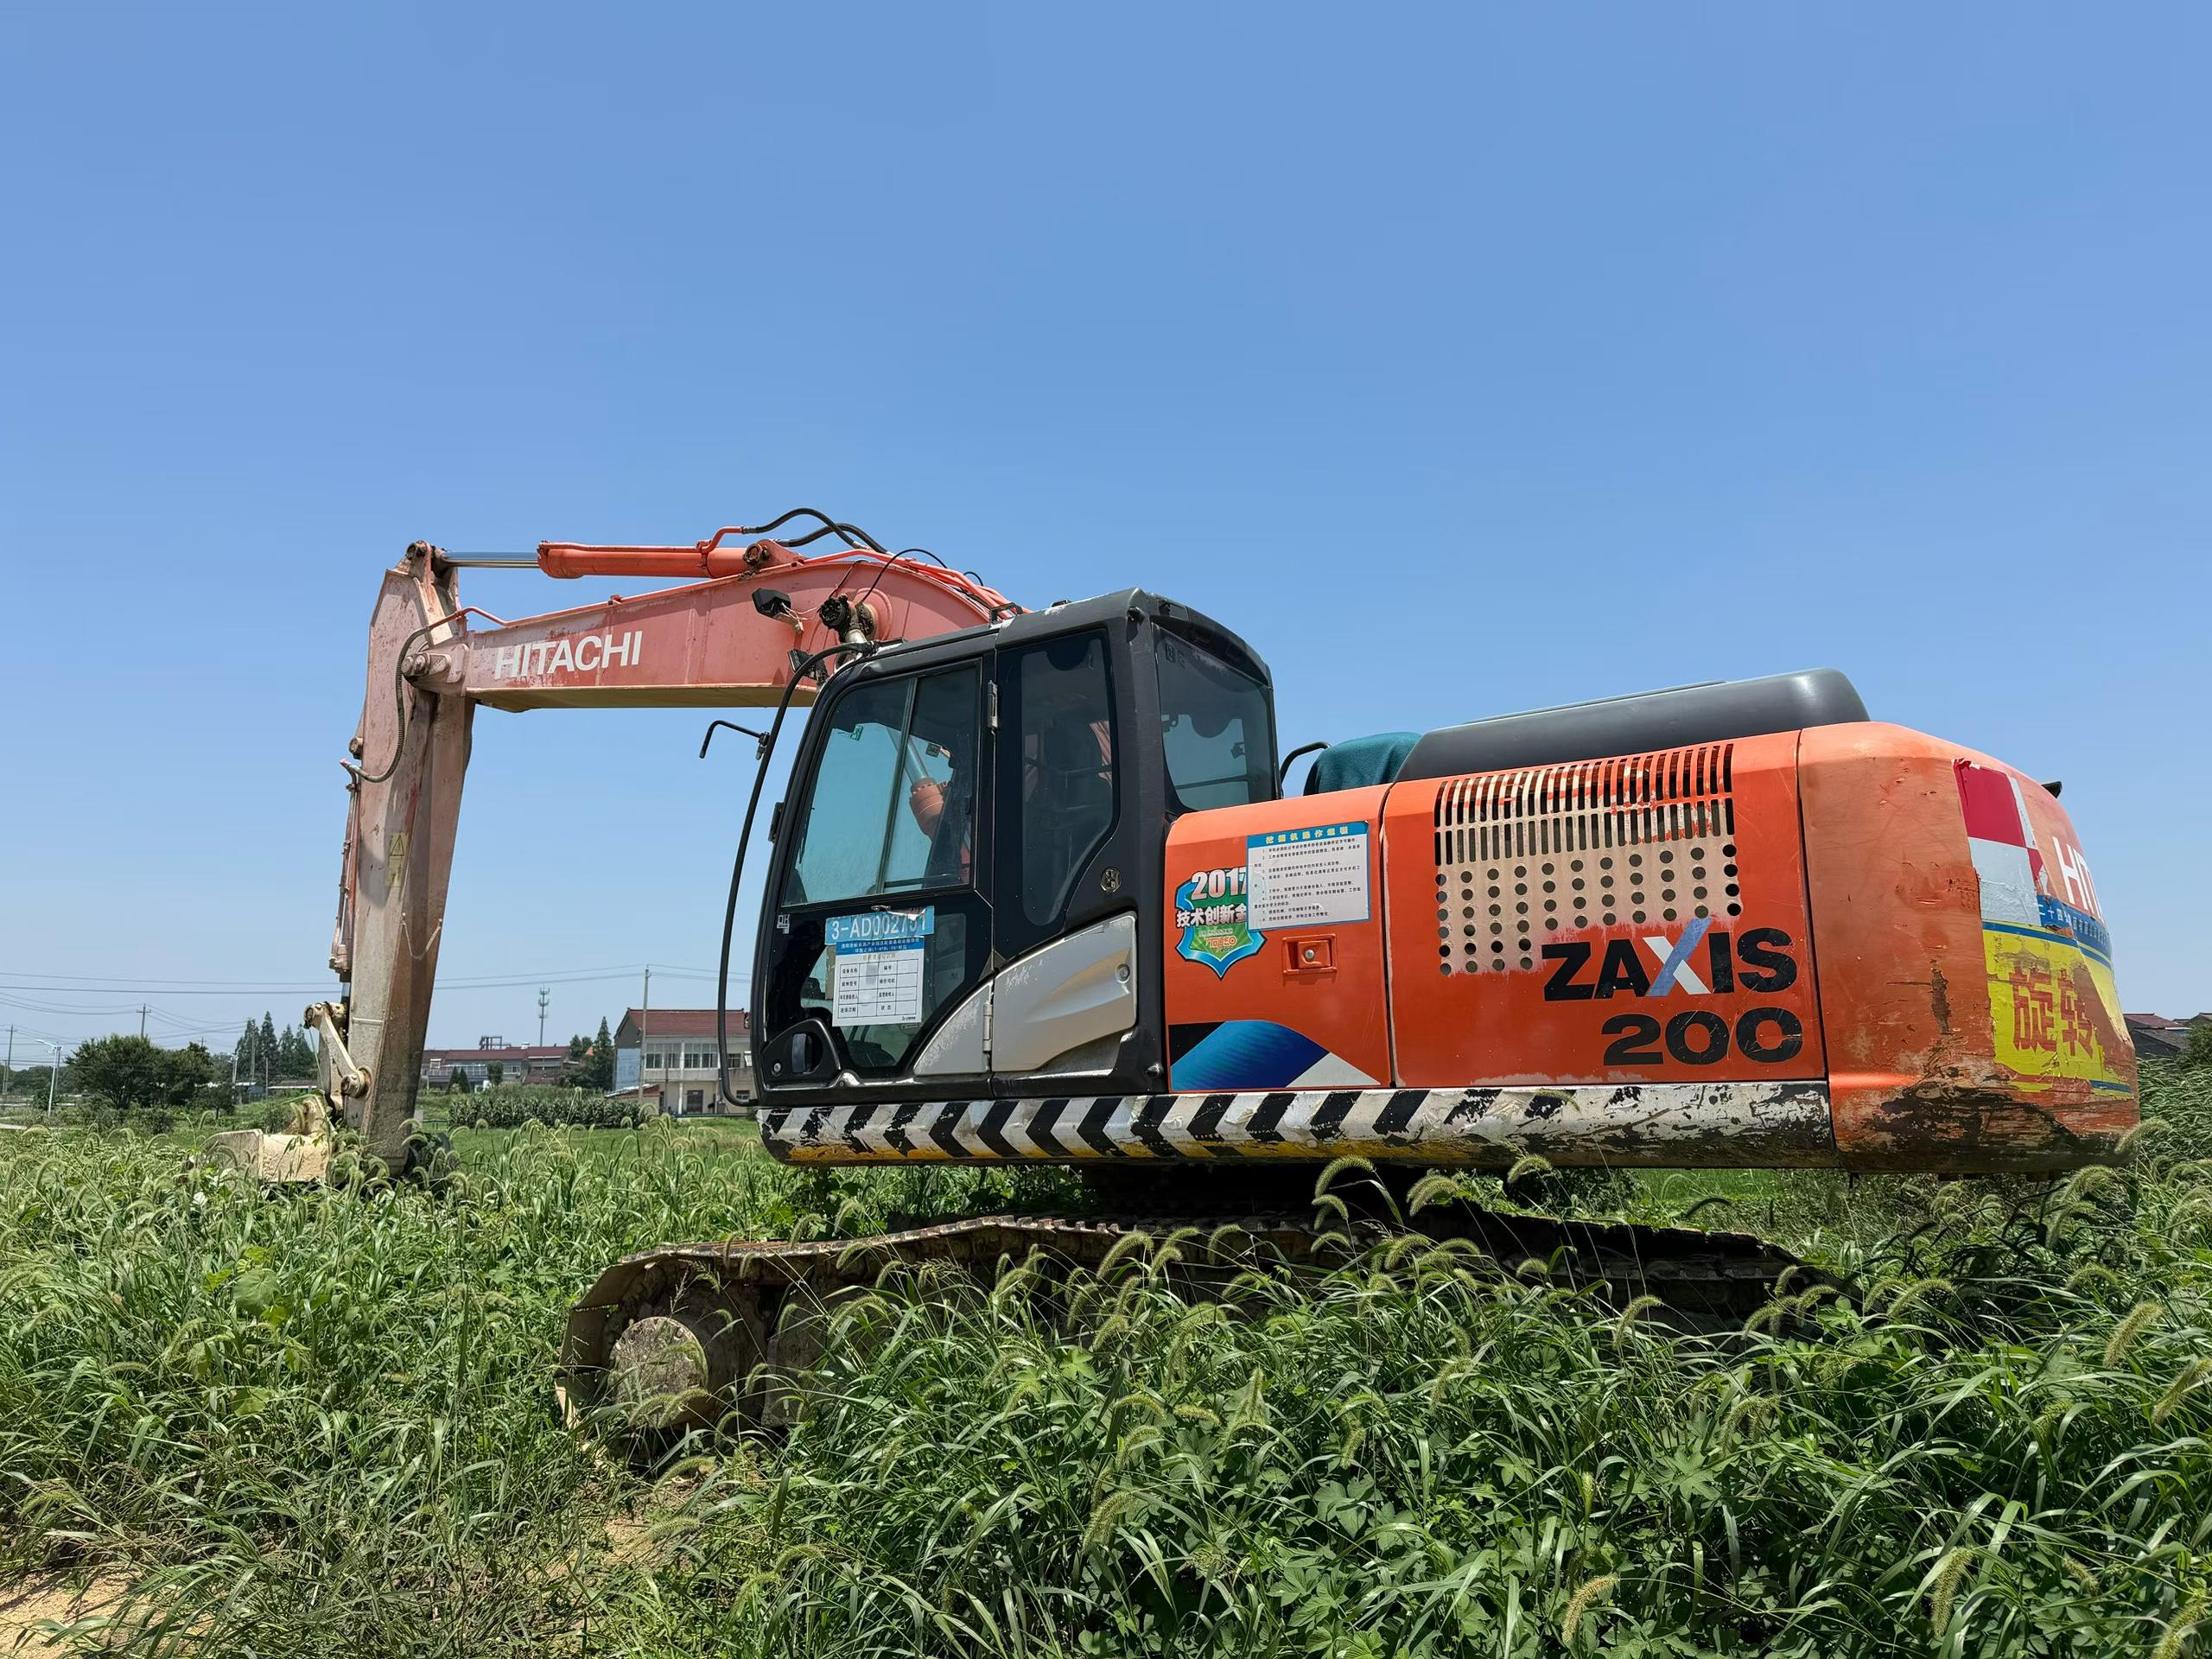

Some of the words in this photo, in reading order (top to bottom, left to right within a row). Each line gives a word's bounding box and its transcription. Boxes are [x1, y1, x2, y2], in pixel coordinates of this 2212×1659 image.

[494, 631, 643, 679] HITACHI
[1192, 867, 1247, 899] 2017
[1541, 918, 1797, 1001] ZAXIS
[1601, 1007, 1803, 1065] 200
